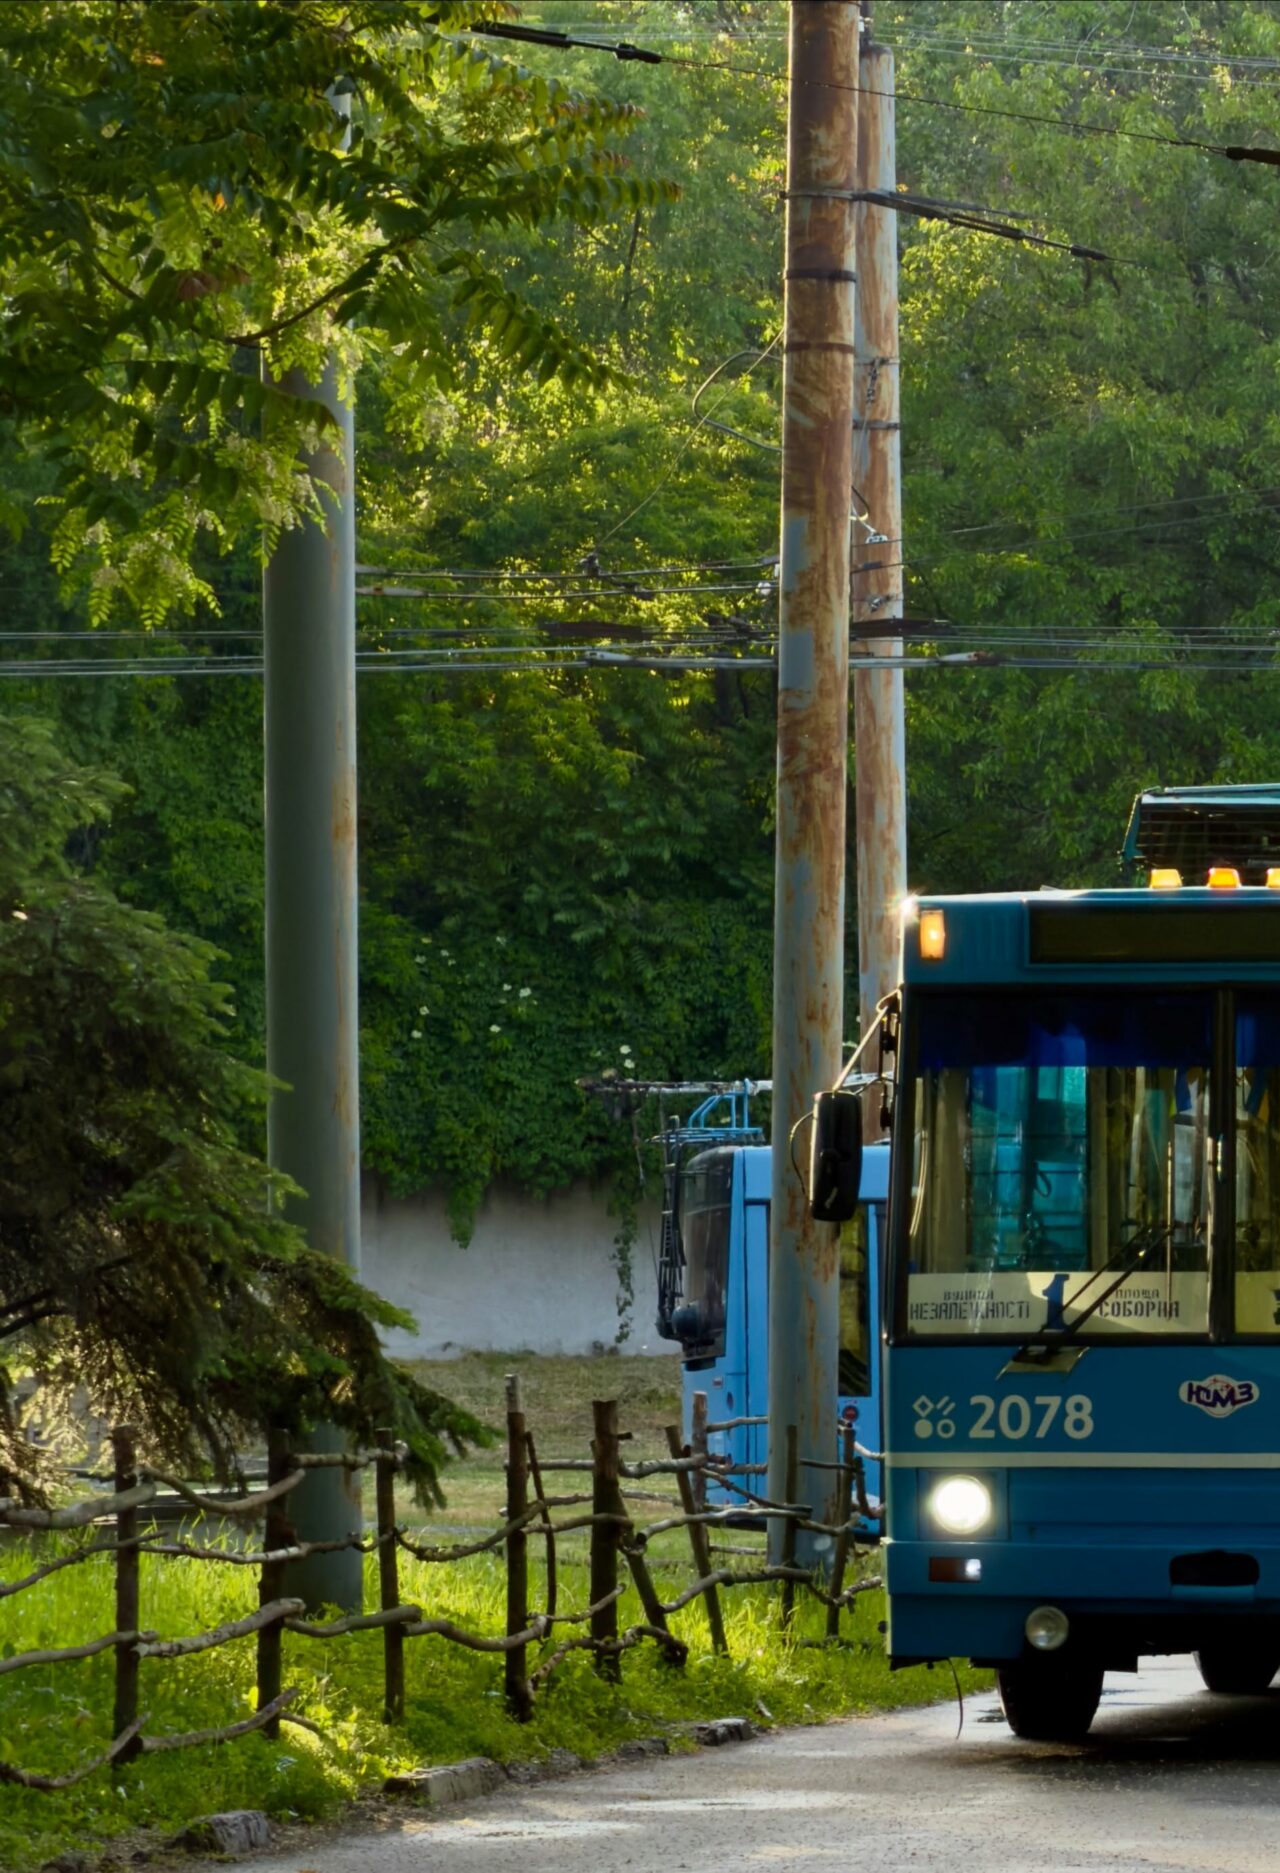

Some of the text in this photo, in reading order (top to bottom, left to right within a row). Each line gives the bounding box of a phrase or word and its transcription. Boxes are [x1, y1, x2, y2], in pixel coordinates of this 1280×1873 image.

[1042, 1273, 1070, 1331] 1
[1099, 1300, 1180, 1319] СОБОРНА
[968, 1395, 1094, 1440] 2078
